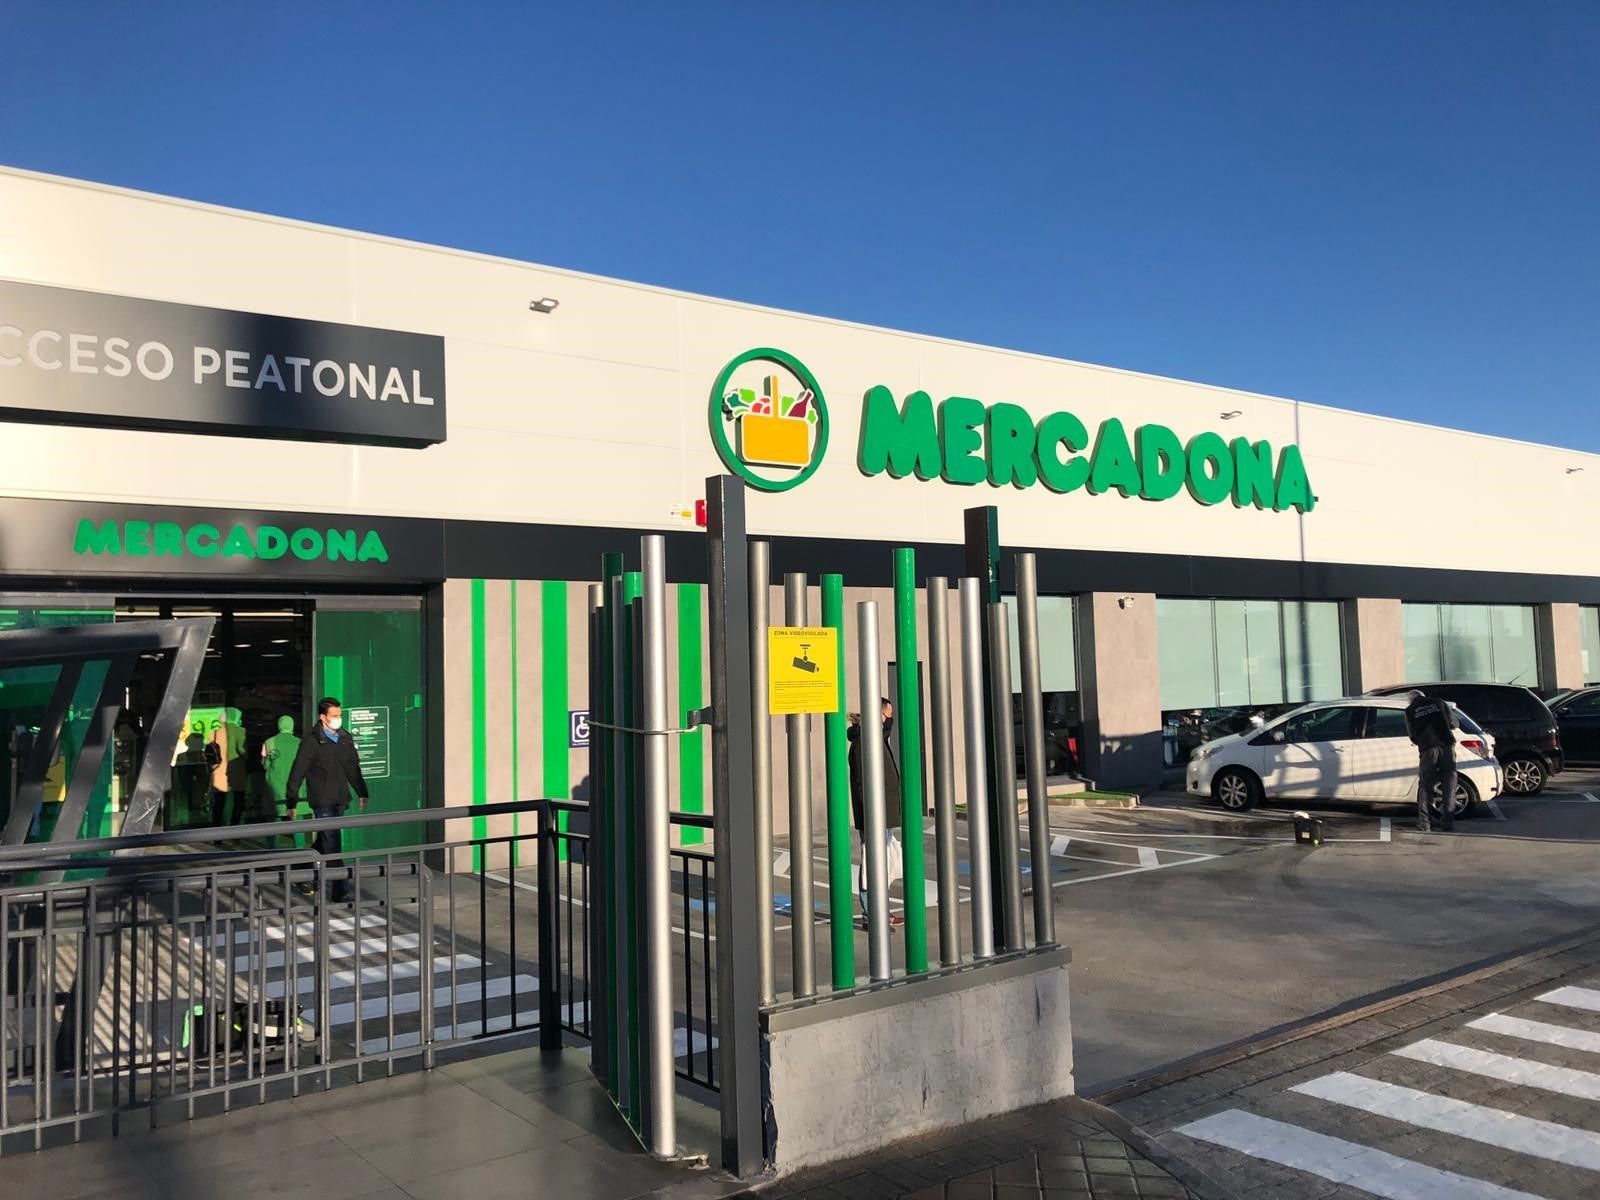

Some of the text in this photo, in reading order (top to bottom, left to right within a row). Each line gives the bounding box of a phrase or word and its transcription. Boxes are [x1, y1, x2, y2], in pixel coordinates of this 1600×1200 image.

[193, 346, 434, 405] PEATONAL
[857, 384, 1316, 513] MERCADONA
[73, 518, 389, 562] MERCADONA
